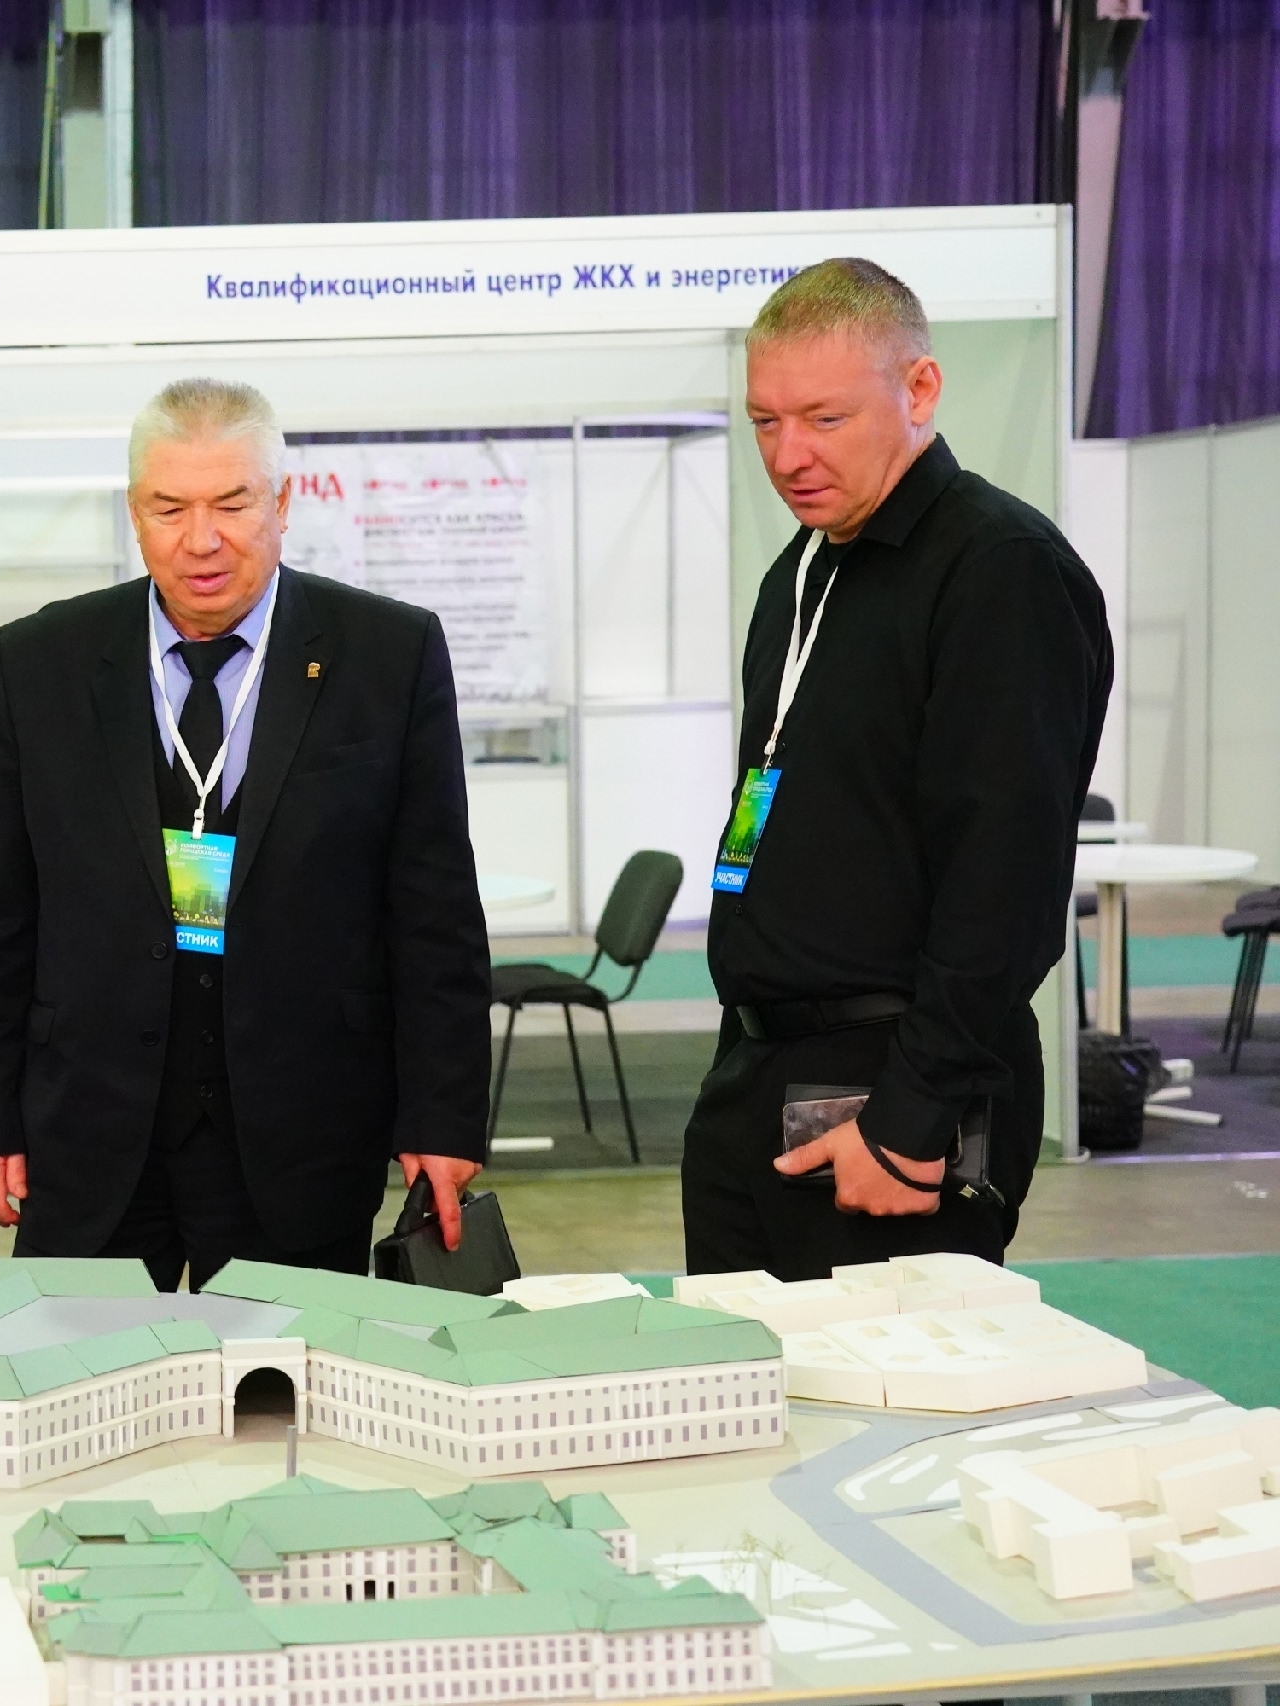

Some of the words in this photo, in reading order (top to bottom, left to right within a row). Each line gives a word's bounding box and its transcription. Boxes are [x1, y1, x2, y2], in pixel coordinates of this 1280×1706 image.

[206, 269, 476, 303] Квалификационный
[487, 271, 562, 297] центр
[573, 264, 636, 289] ЖКХ
[646, 269, 662, 288] и
[671, 265, 801, 292] энергетик
[176, 931, 219, 948] СТНИК
